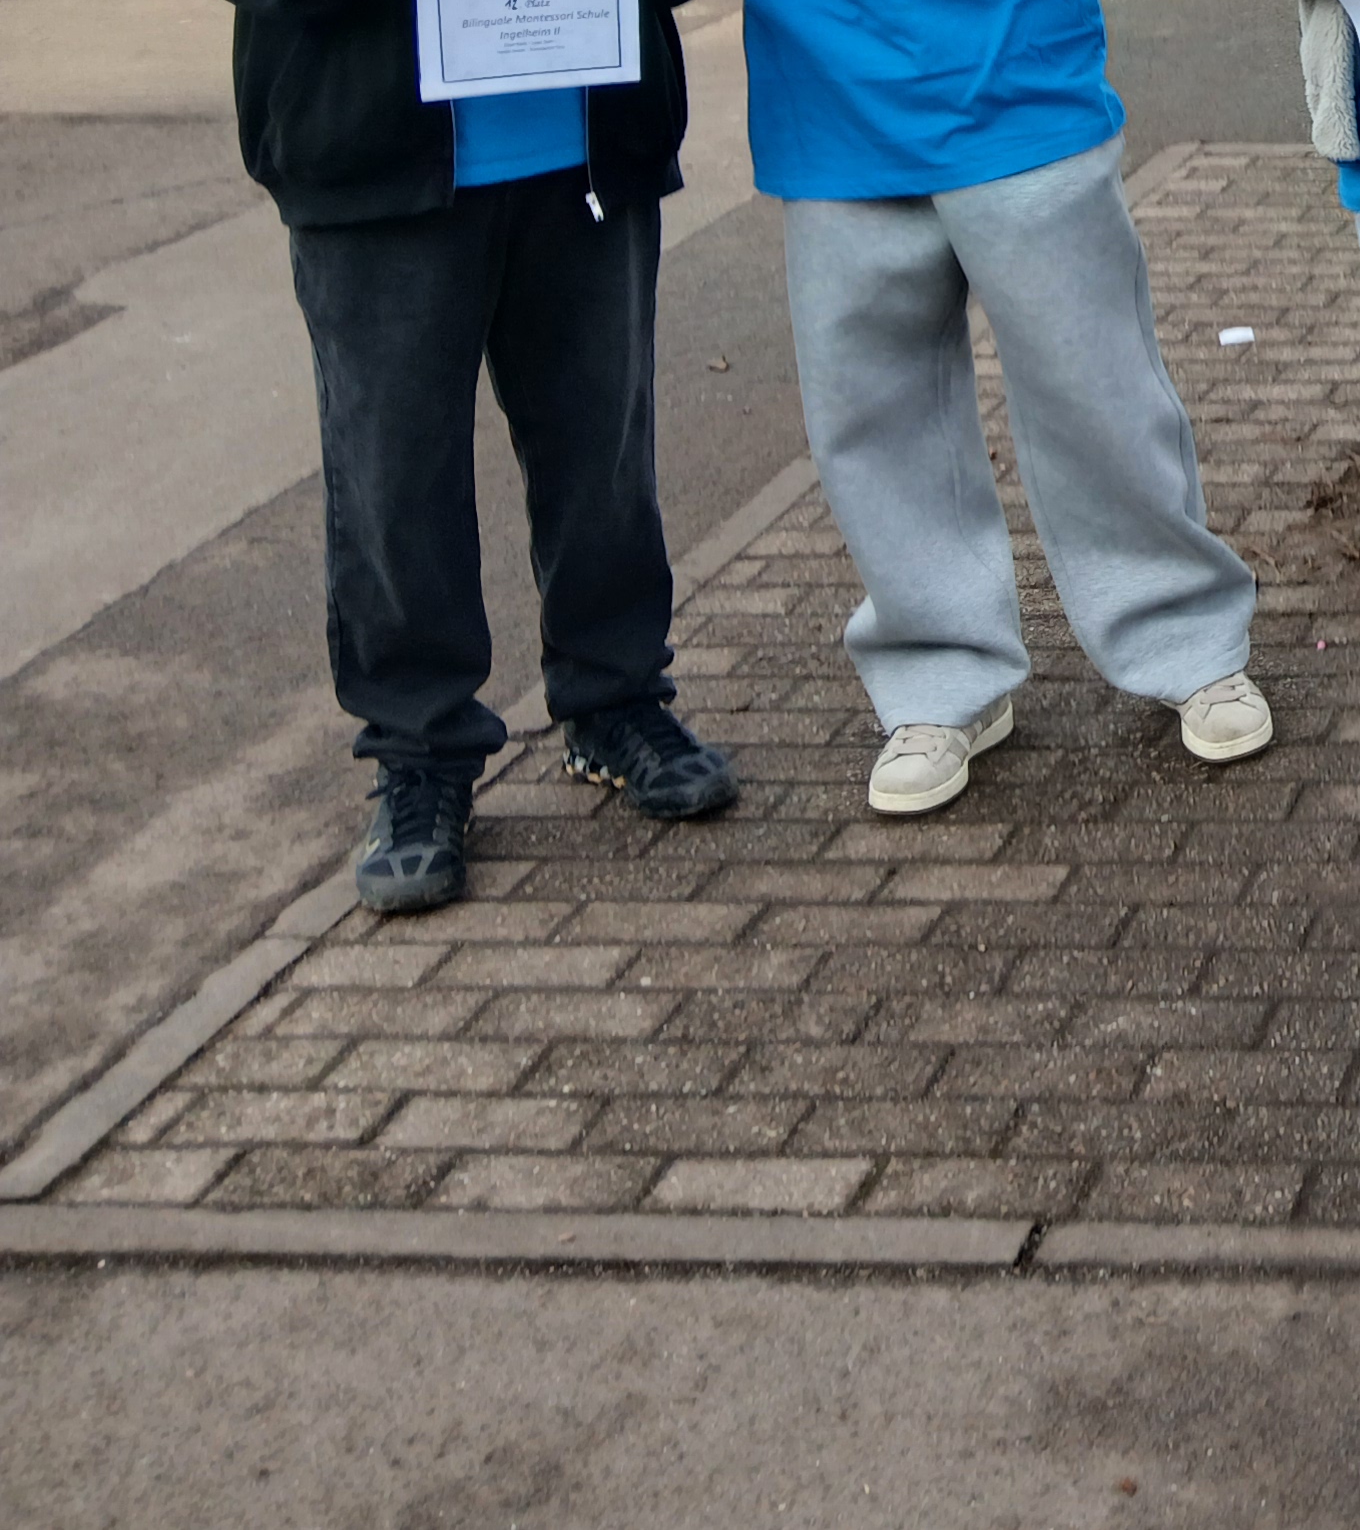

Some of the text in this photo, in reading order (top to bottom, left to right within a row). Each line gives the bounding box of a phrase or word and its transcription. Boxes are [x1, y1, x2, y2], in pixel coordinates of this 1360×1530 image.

[462, 10, 610, 29] Bilinguale Montessori Schule
[500, 28, 551, 41] Ingelheim
